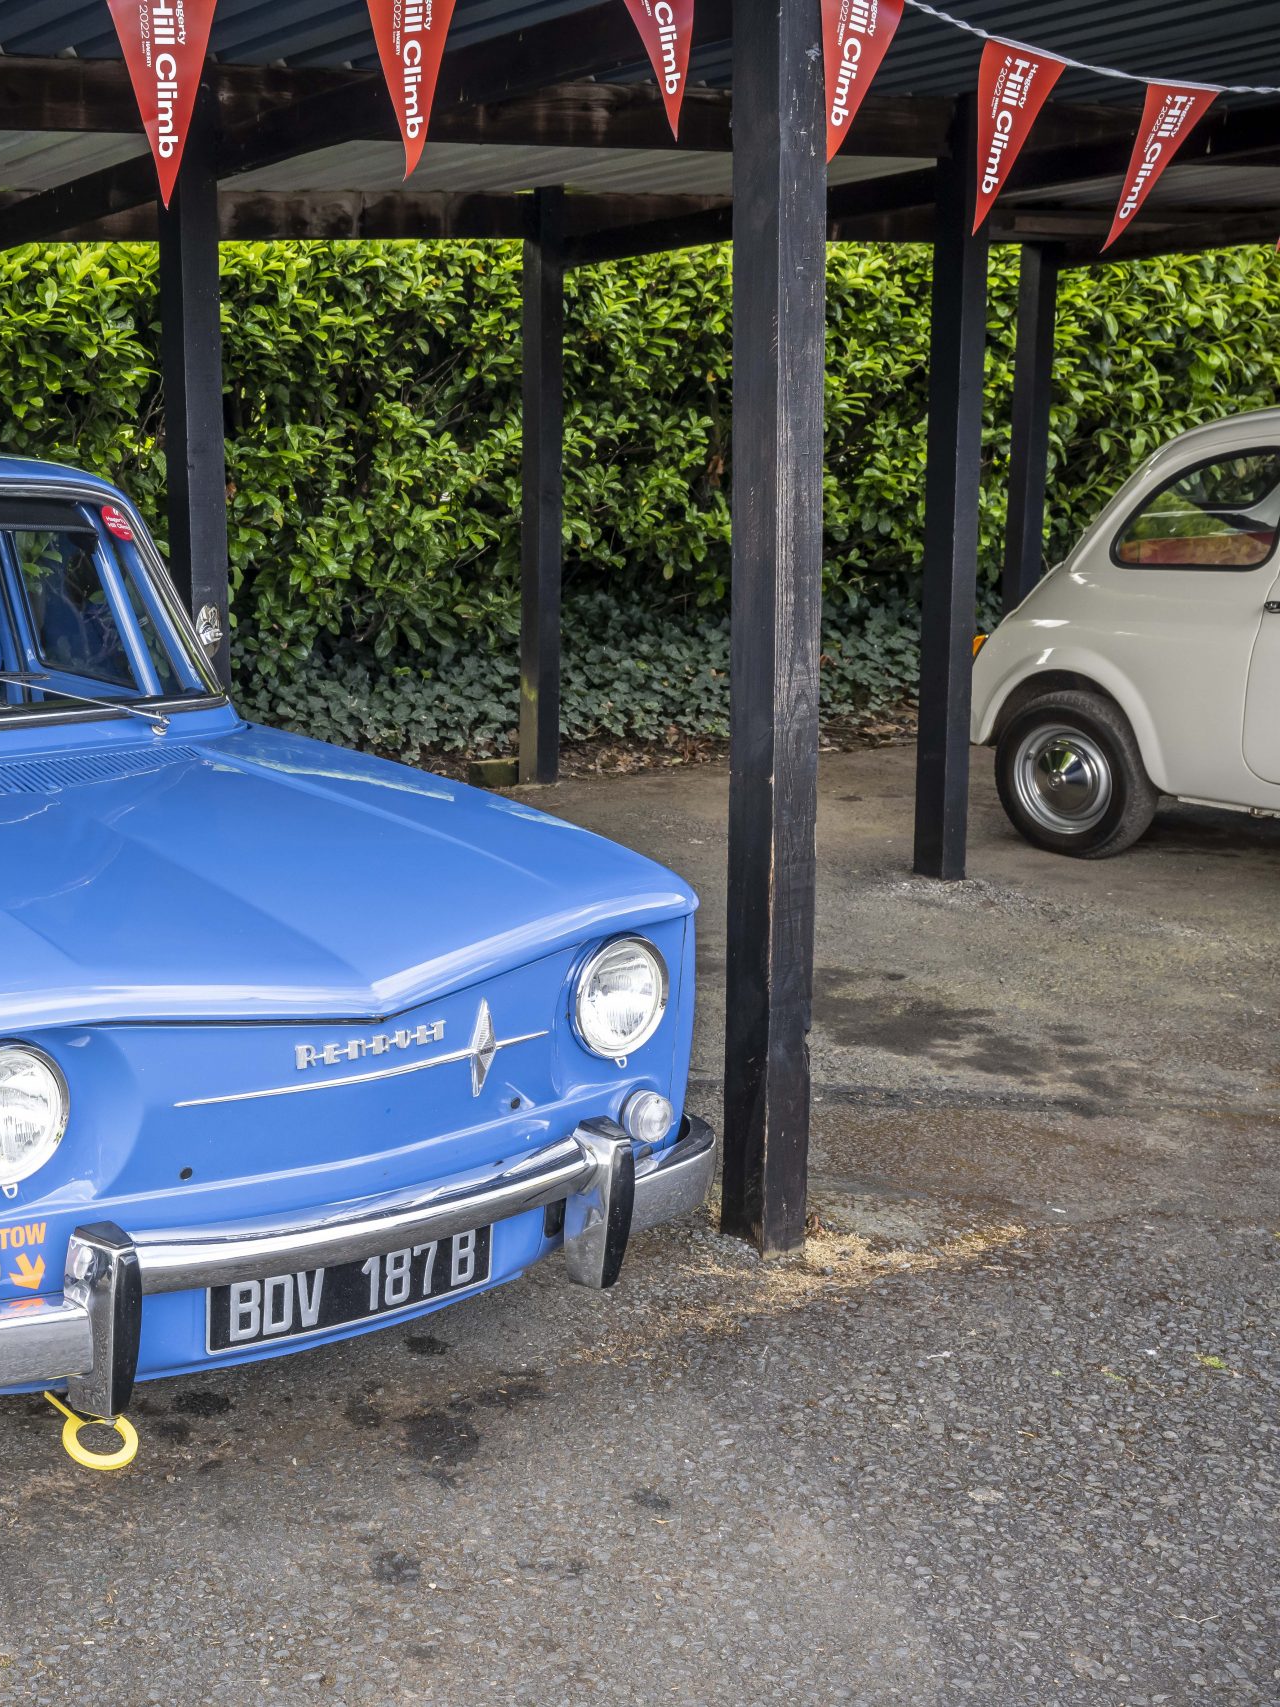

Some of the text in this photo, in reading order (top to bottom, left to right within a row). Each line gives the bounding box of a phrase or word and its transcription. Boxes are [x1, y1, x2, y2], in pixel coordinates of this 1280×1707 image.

[139, 5, 150, 39] 2022
[654, 1, 681, 95] Climb
[155, 53, 179, 158] Climb
[403, 0, 424, 139] ill Climb
[830, 37, 862, 127] Climb
[993, 67, 1008, 96] 2022
[1018, 64, 1039, 109] Hagerty
[981, 58, 1031, 194] Hill Climb
[1119, 95, 1189, 219] Hill Climb
[295, 1019, 448, 1070] RENAULT
[229, 1228, 477, 1342] BDV 187 B
